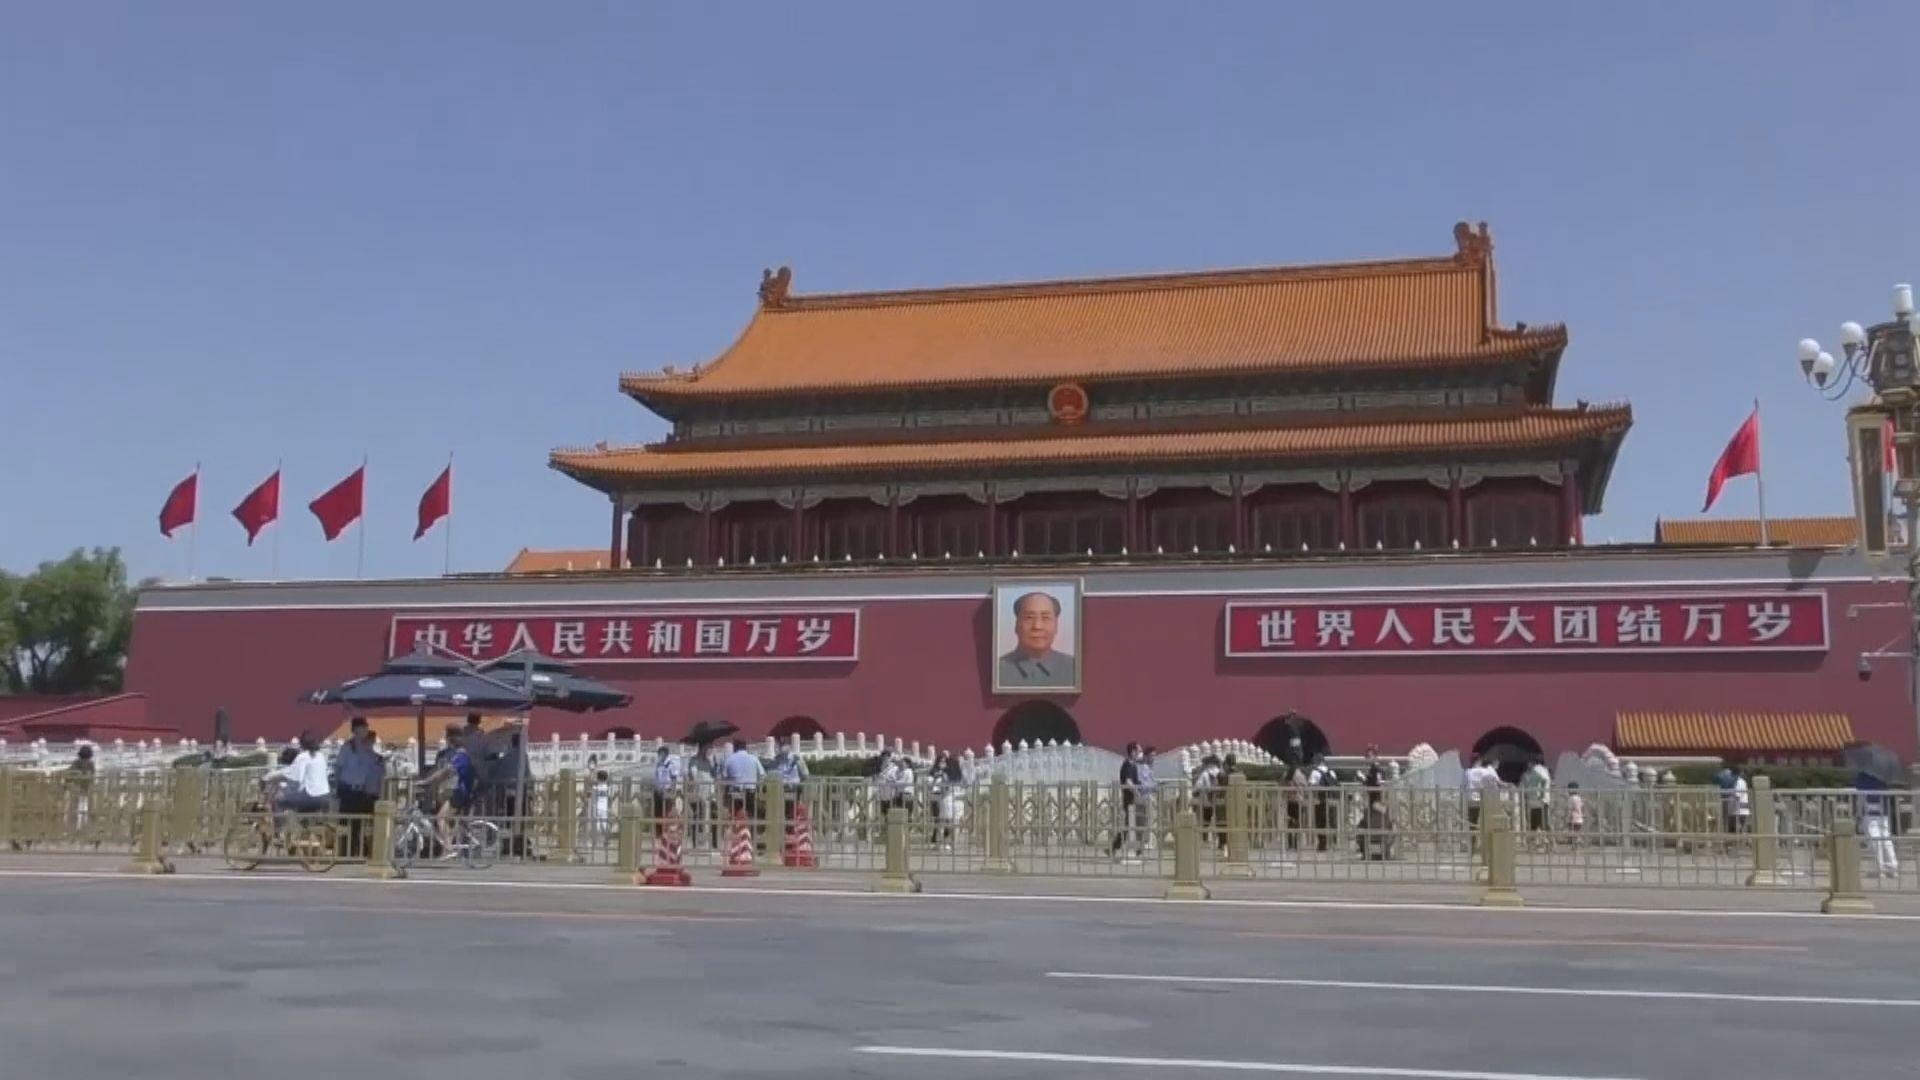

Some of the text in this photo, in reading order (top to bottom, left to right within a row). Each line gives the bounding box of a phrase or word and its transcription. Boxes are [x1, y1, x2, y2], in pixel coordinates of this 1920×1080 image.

[414, 618, 832, 656] 中华人民共和国万岁
[1257, 602, 1792, 647] 世界人民大团结万岁
